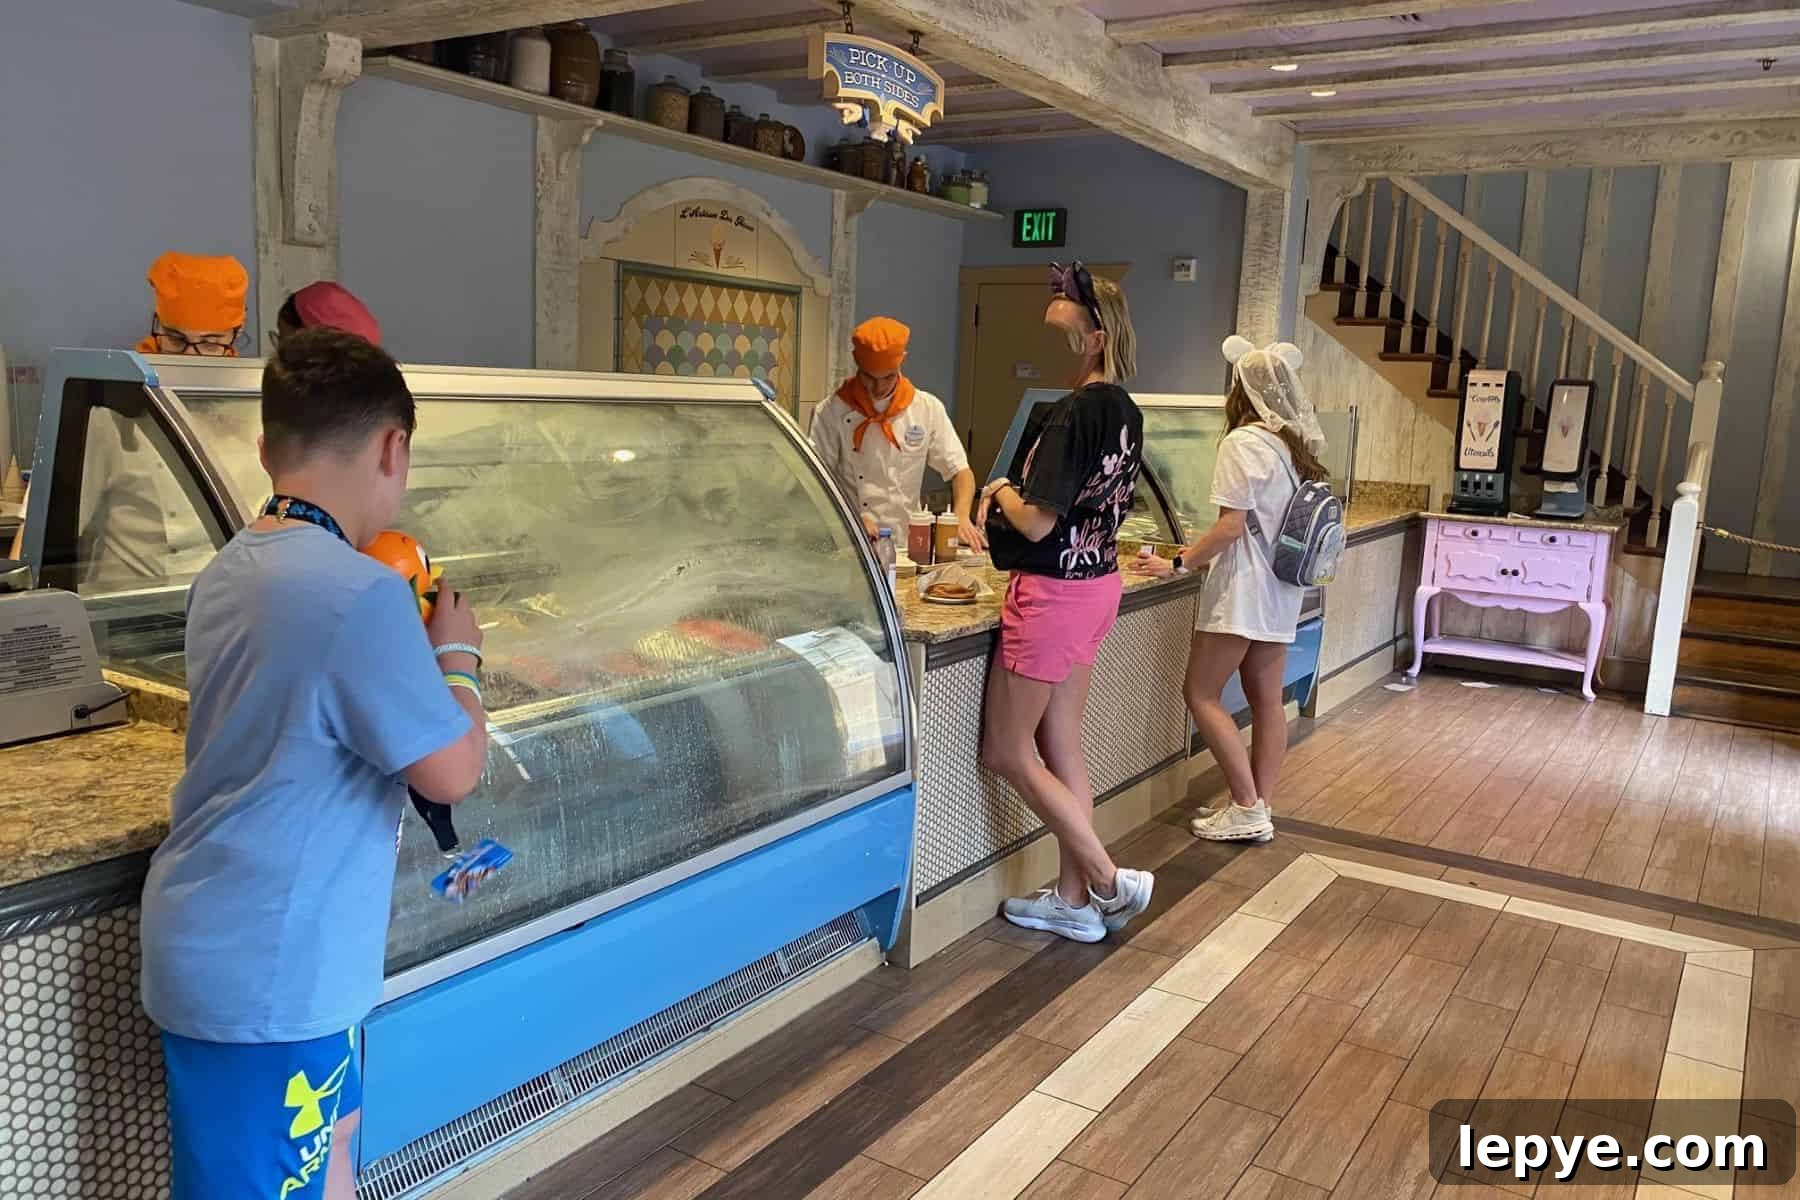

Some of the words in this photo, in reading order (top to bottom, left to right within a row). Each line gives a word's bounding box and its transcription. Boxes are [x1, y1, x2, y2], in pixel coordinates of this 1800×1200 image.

[848, 47, 889, 73] PICK
[893, 61, 916, 85] UP
[844, 71, 881, 89] BOTH
[883, 80, 920, 108] SIDES
[1022, 212, 1056, 241] EXIT
